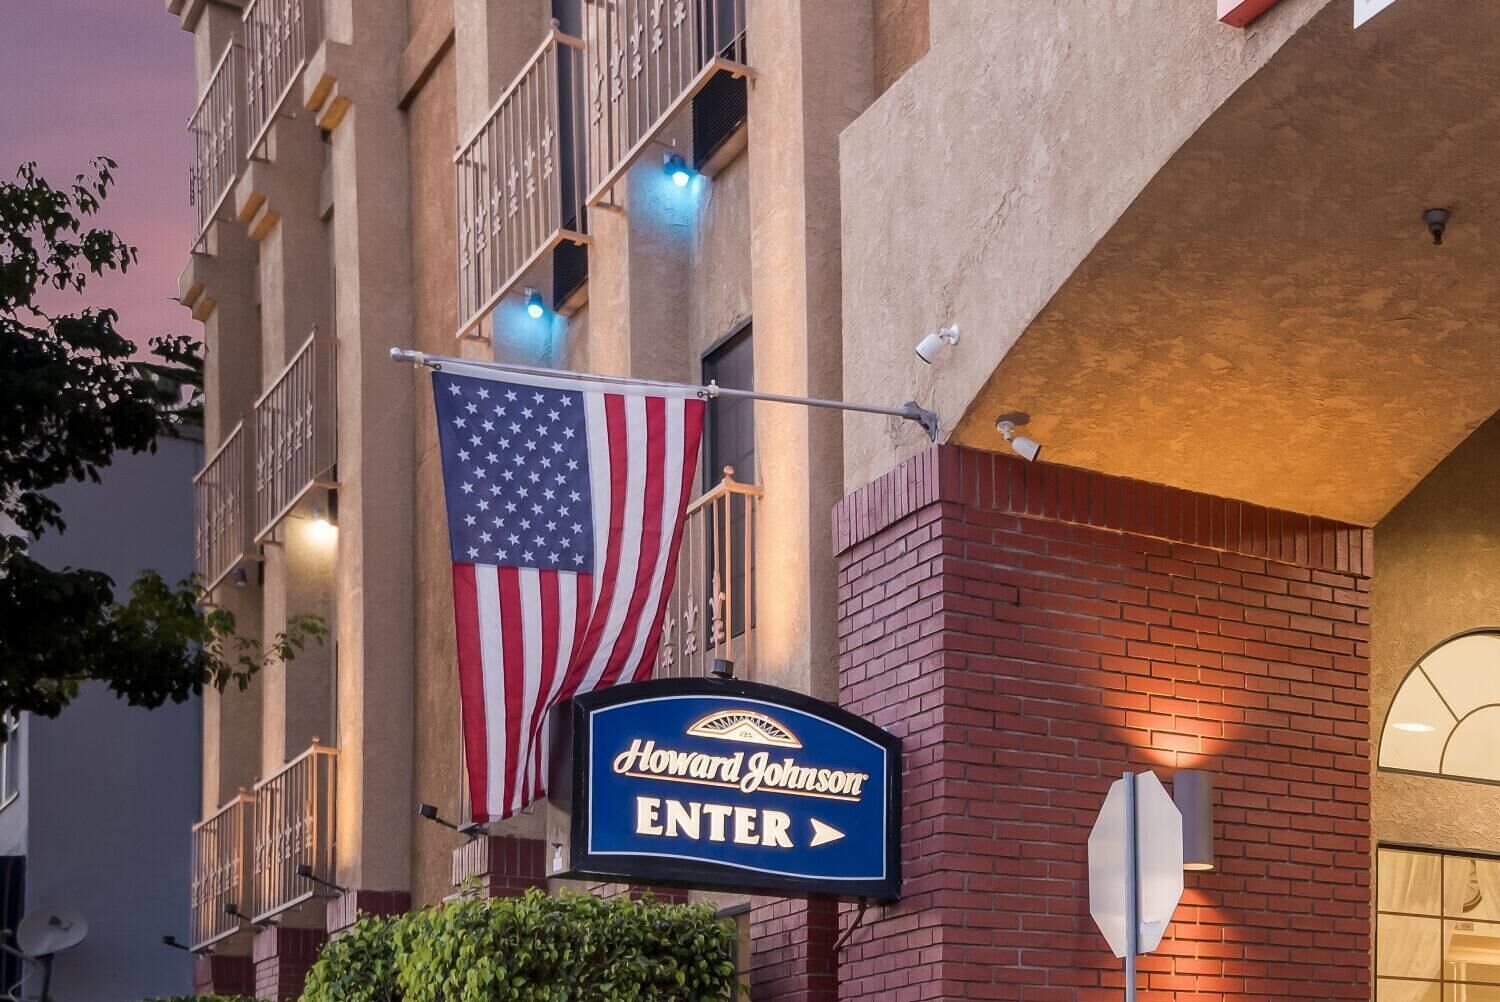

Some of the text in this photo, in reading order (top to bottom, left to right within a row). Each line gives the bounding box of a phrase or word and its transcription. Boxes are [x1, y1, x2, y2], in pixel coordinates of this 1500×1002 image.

[612, 738, 864, 796] Howard Johnson
[635, 795, 795, 849] ENTER
